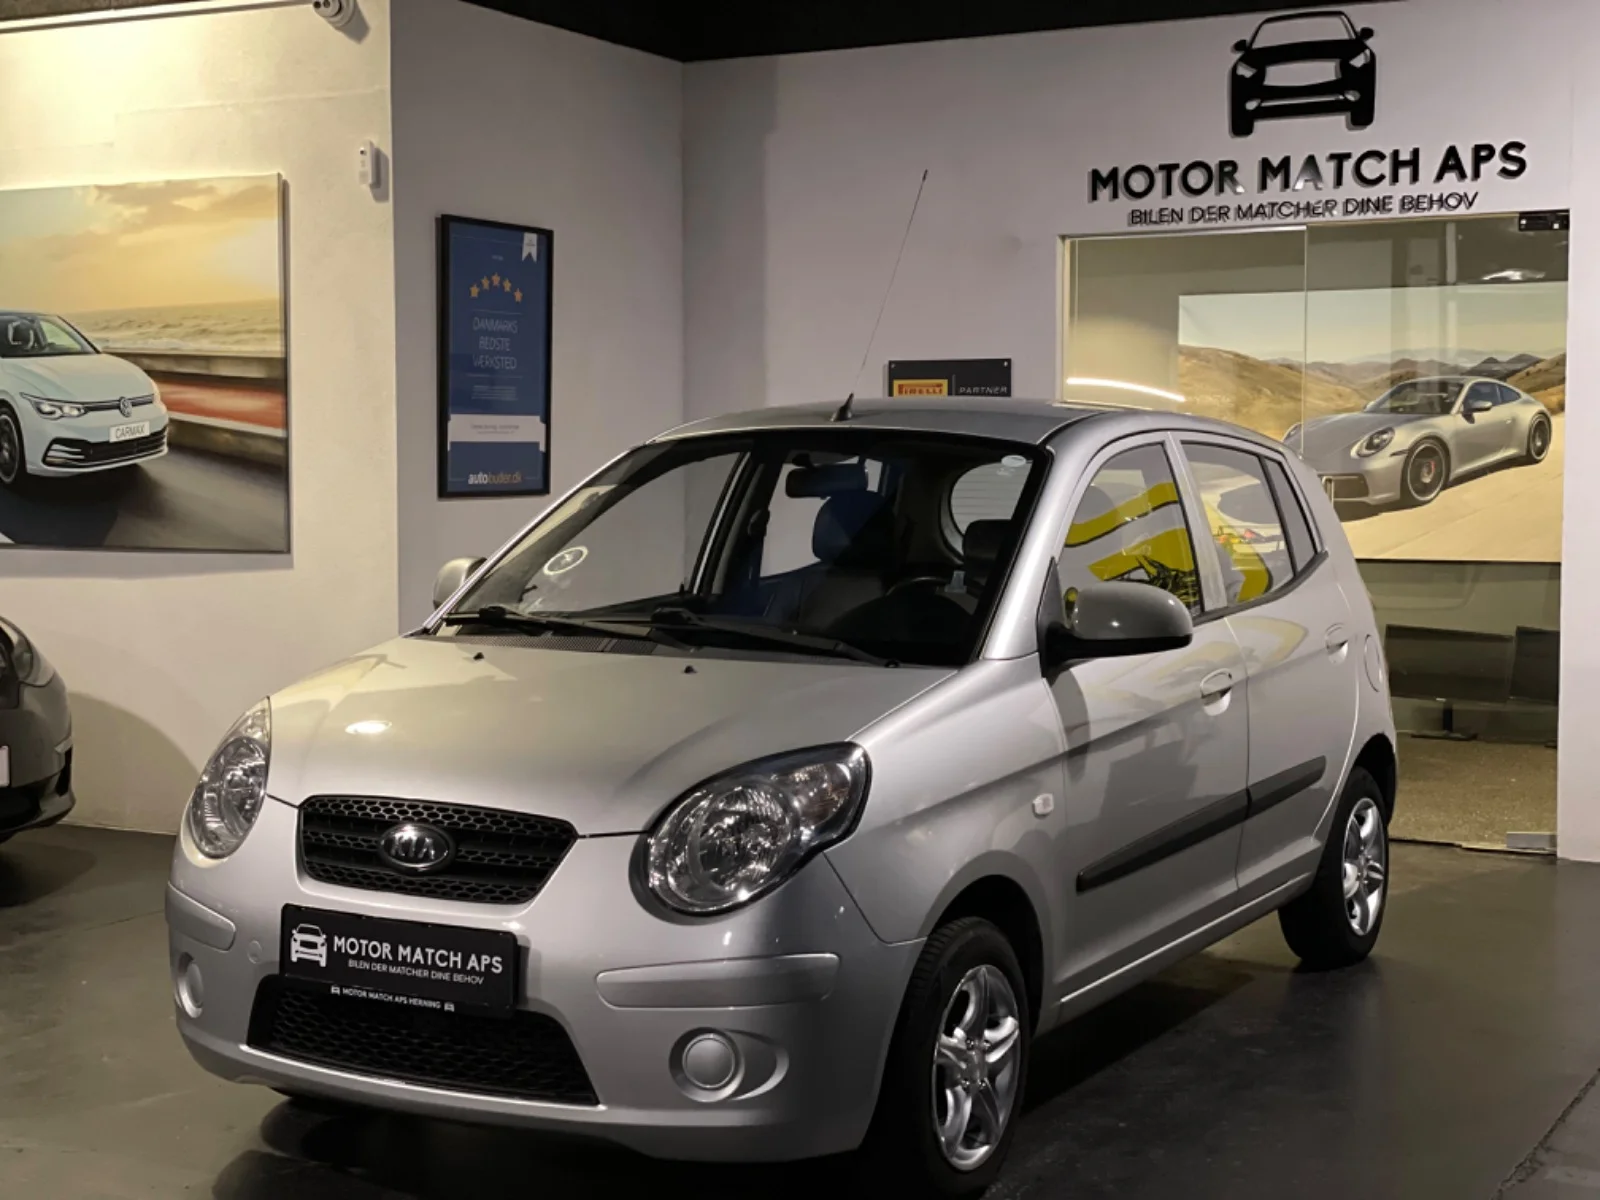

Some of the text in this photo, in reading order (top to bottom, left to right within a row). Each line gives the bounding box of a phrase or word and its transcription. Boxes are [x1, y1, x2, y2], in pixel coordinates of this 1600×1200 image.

[1088, 141, 1527, 202] MOTOR MATCH APS
[1129, 191, 1478, 225] BILEN DER MATCHER DINE BEHOV
[116, 423, 145, 438] CARMAX
[333, 936, 503, 974] MOTOR MATCH APS
[348, 959, 484, 986] BILEN DER MATCHER DINE BEHOV
[342, 987, 442, 1009] MOTOR MATCH APS HERNING
